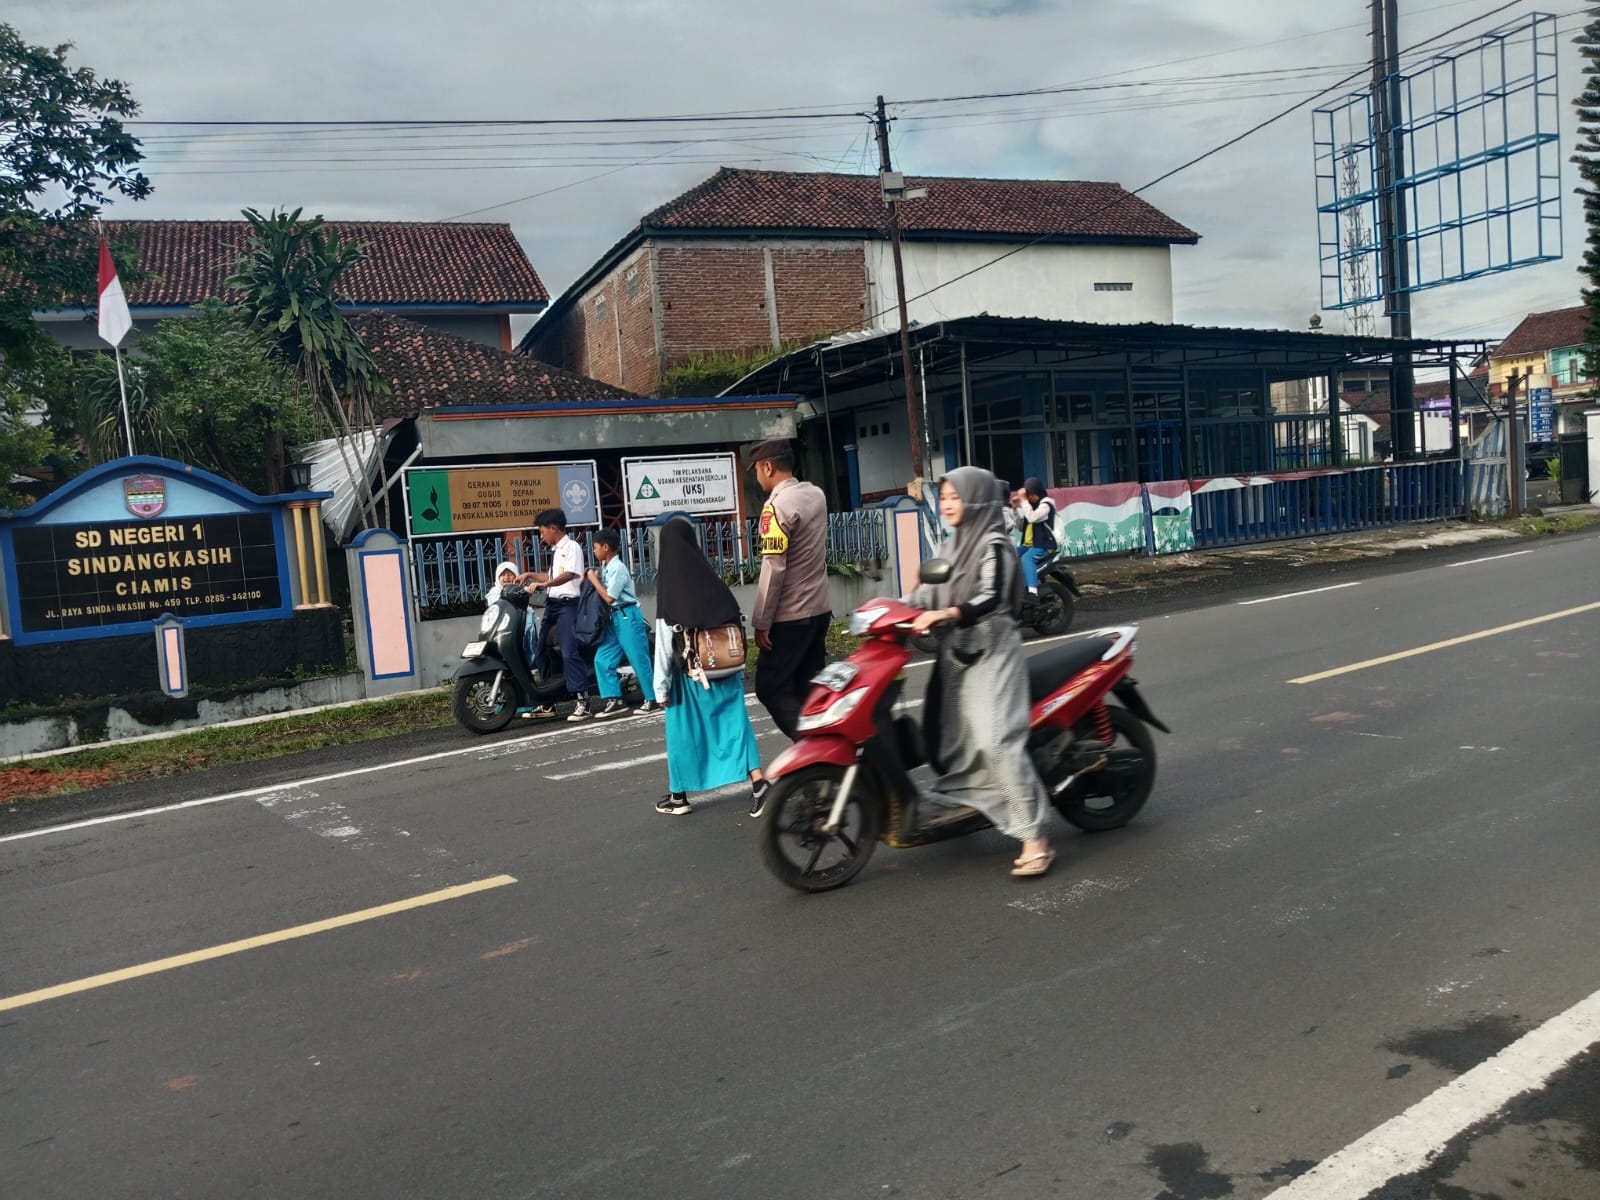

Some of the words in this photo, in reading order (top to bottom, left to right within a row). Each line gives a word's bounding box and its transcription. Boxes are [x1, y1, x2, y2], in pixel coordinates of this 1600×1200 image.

[682, 467, 712, 476] PELAKSANA
[467, 480, 500, 489] GERAKAN
[682, 482, 706, 497] (UKS)
[478, 490, 502, 498] GUGUS
[512, 489, 534, 497] DEPAN
[452, 511, 494, 520] PANGKALAN
[495, 510, 508, 518] SDN
[75, 529, 102, 548] SD
[109, 524, 185, 546] NEGERI
[192, 523, 204, 540] 1
[67, 547, 232, 576] SINDANGKASIH
[115, 576, 192, 596] CIAMIS
[45, 610, 60, 618] JL.
[61, 607, 82, 617] RAYA
[149, 601, 162, 609] No.
[164, 598, 181, 607] 459
[185, 596, 202, 605] TLP.
